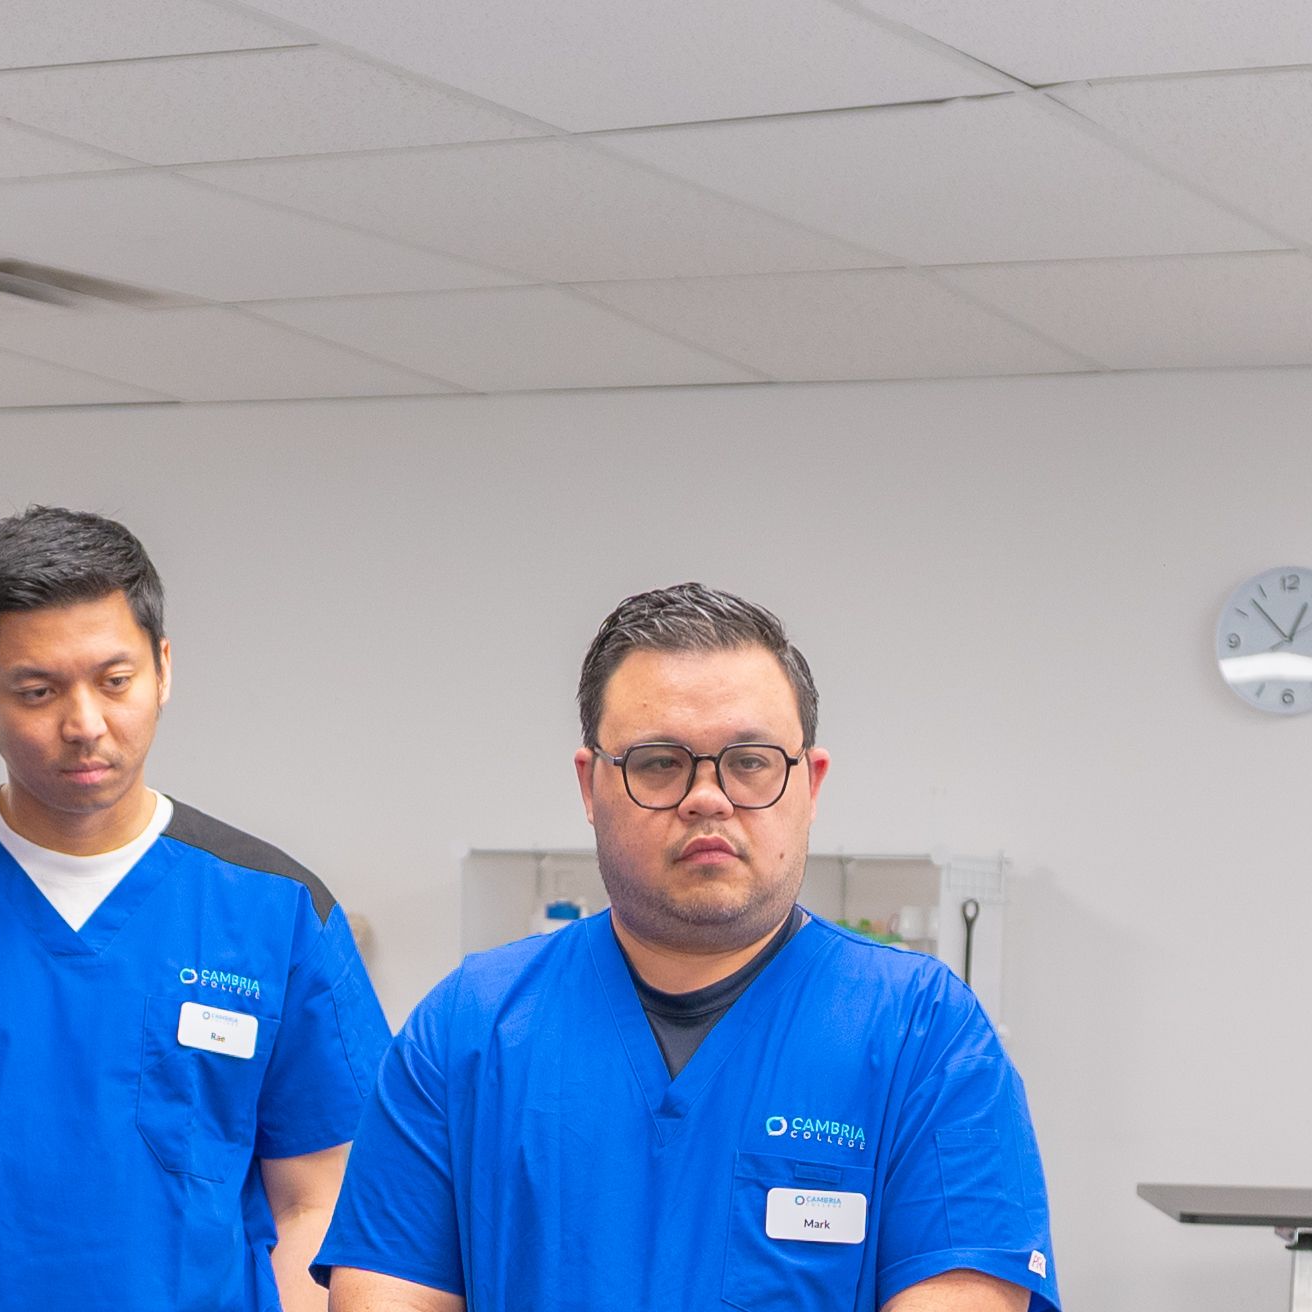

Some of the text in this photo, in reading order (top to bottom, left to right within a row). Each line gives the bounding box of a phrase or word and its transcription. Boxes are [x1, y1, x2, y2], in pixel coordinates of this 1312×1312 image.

[1280, 574, 1300, 591] 12
[1227, 632, 1241, 649] 9
[1281, 688, 1295, 705] 6
[201, 969, 260, 993] CAMBRIA
[211, 1032, 226, 1043] Rae
[792, 1117, 865, 1141] CAMBRIA
[790, 1130, 866, 1150] COLLEGE
[803, 1219, 830, 1230] Mark
